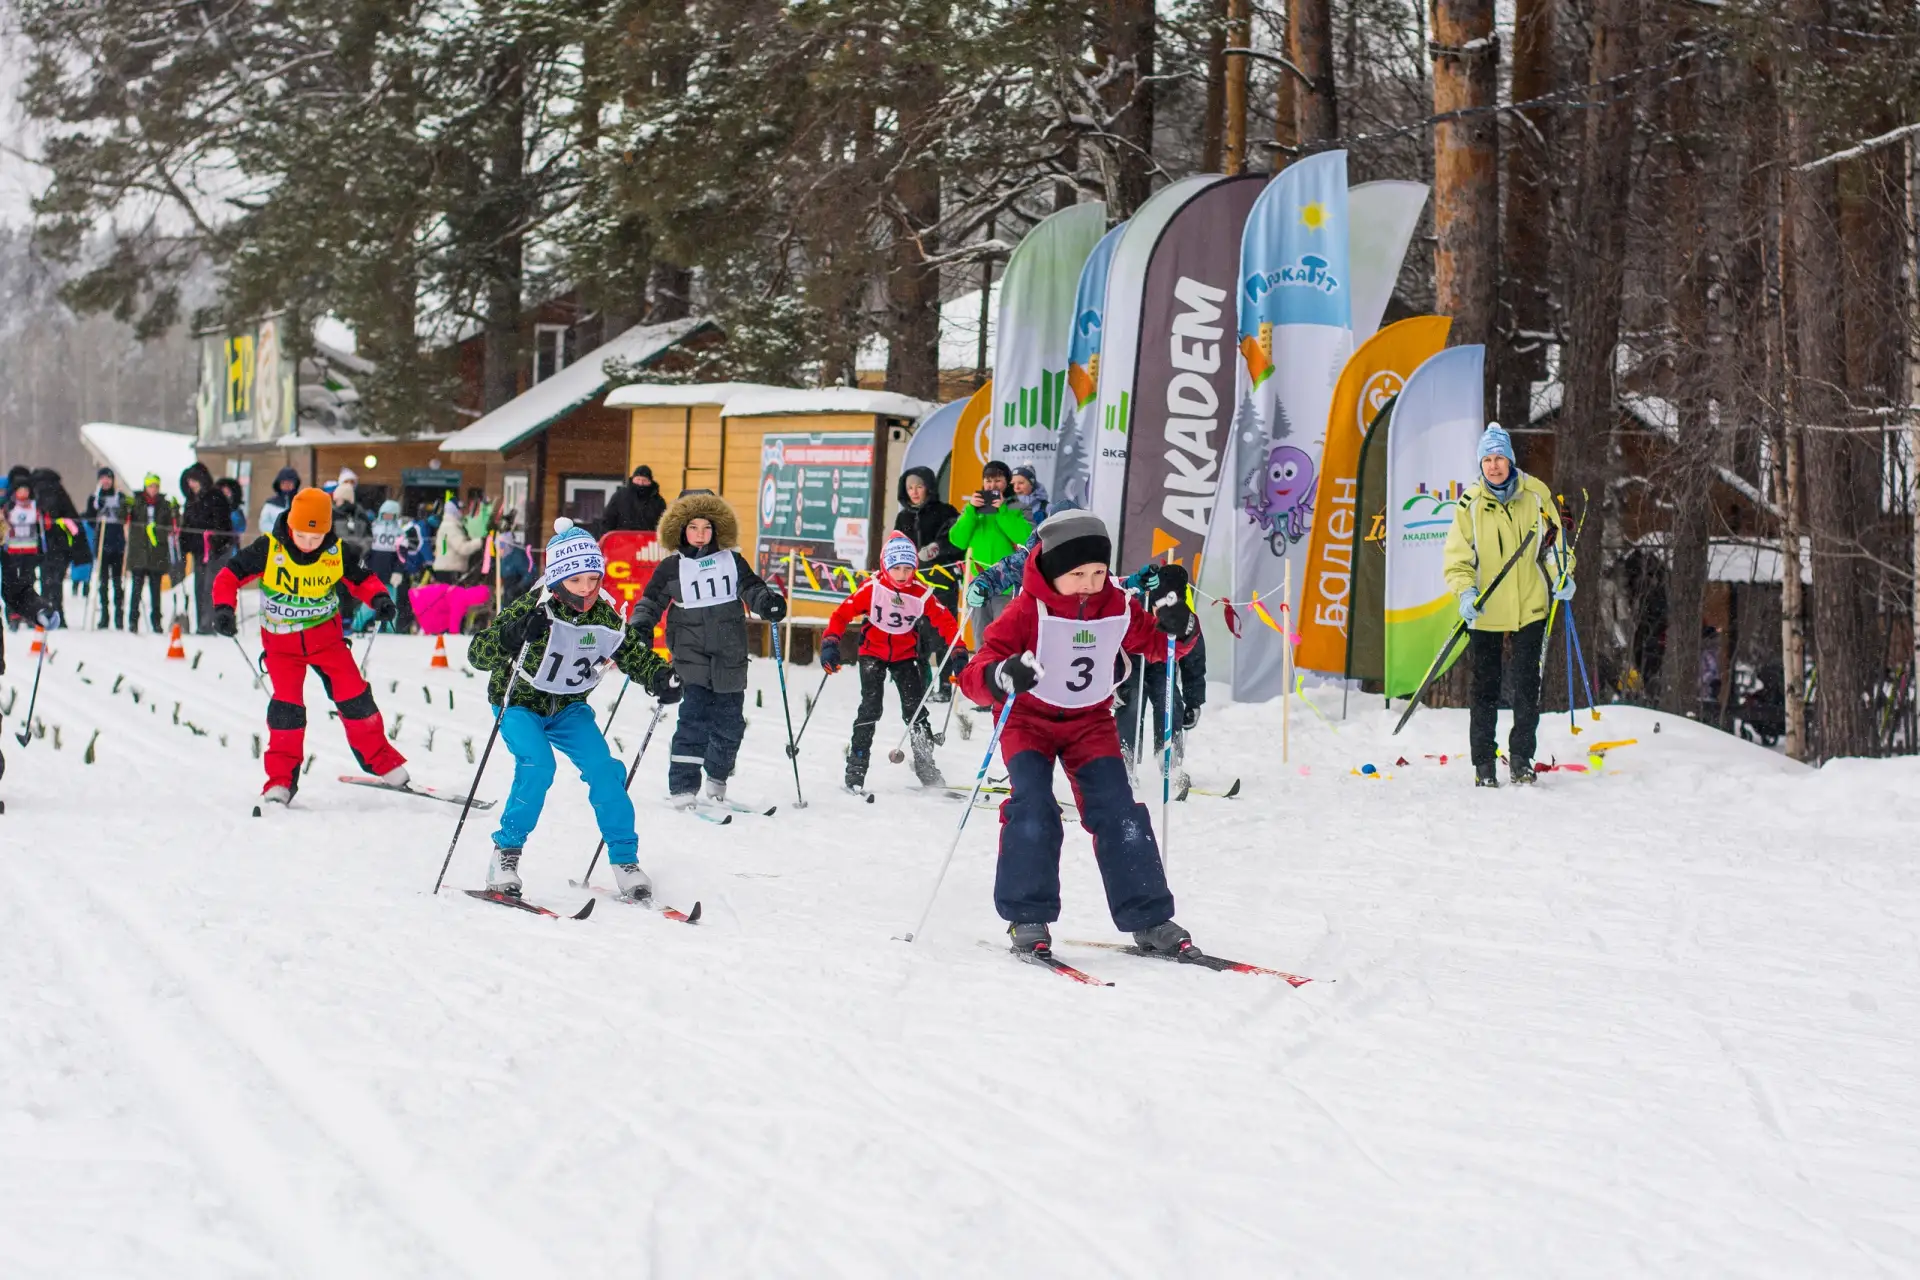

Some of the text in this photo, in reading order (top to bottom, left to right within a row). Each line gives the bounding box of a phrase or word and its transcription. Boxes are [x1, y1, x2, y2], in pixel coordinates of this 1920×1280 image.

[303, 576, 332, 587] NIKA
[690, 574, 732, 601] 111
[1066, 656, 1095, 692] 3
